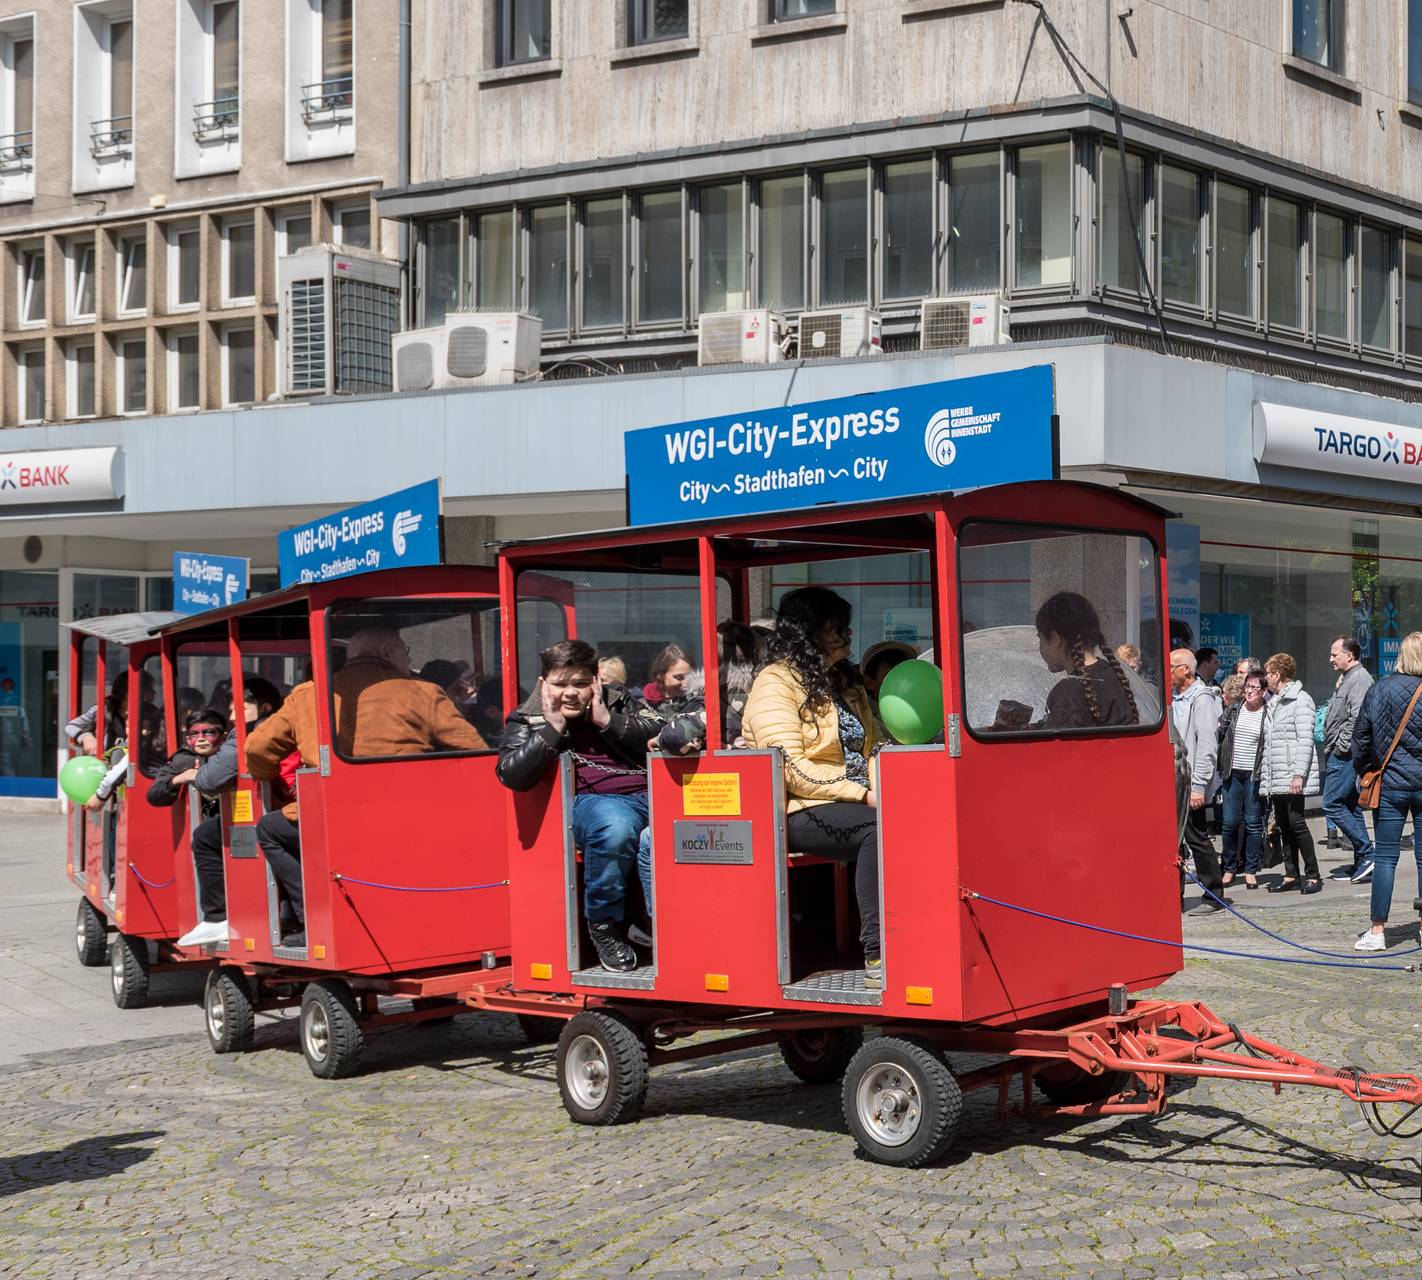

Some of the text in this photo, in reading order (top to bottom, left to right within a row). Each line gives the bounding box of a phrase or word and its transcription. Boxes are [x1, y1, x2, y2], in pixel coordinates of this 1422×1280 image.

[950, 406, 974, 418] WERBE
[951, 412, 1001, 428] GEMEINSCHAFT
[665, 406, 900, 465] WGI-City-Express
[951, 424, 992, 438] INNENSTADT
[20, 464, 70, 488] BANK
[679, 456, 888, 504] City Stadthafen City
[294, 511, 384, 557] WGI-City-Express
[321, 556, 357, 579] Stadthafen
[366, 549, 380, 568] City
[17, 606, 77, 618] TARG
[682, 839, 744, 851] KOCZY Events
